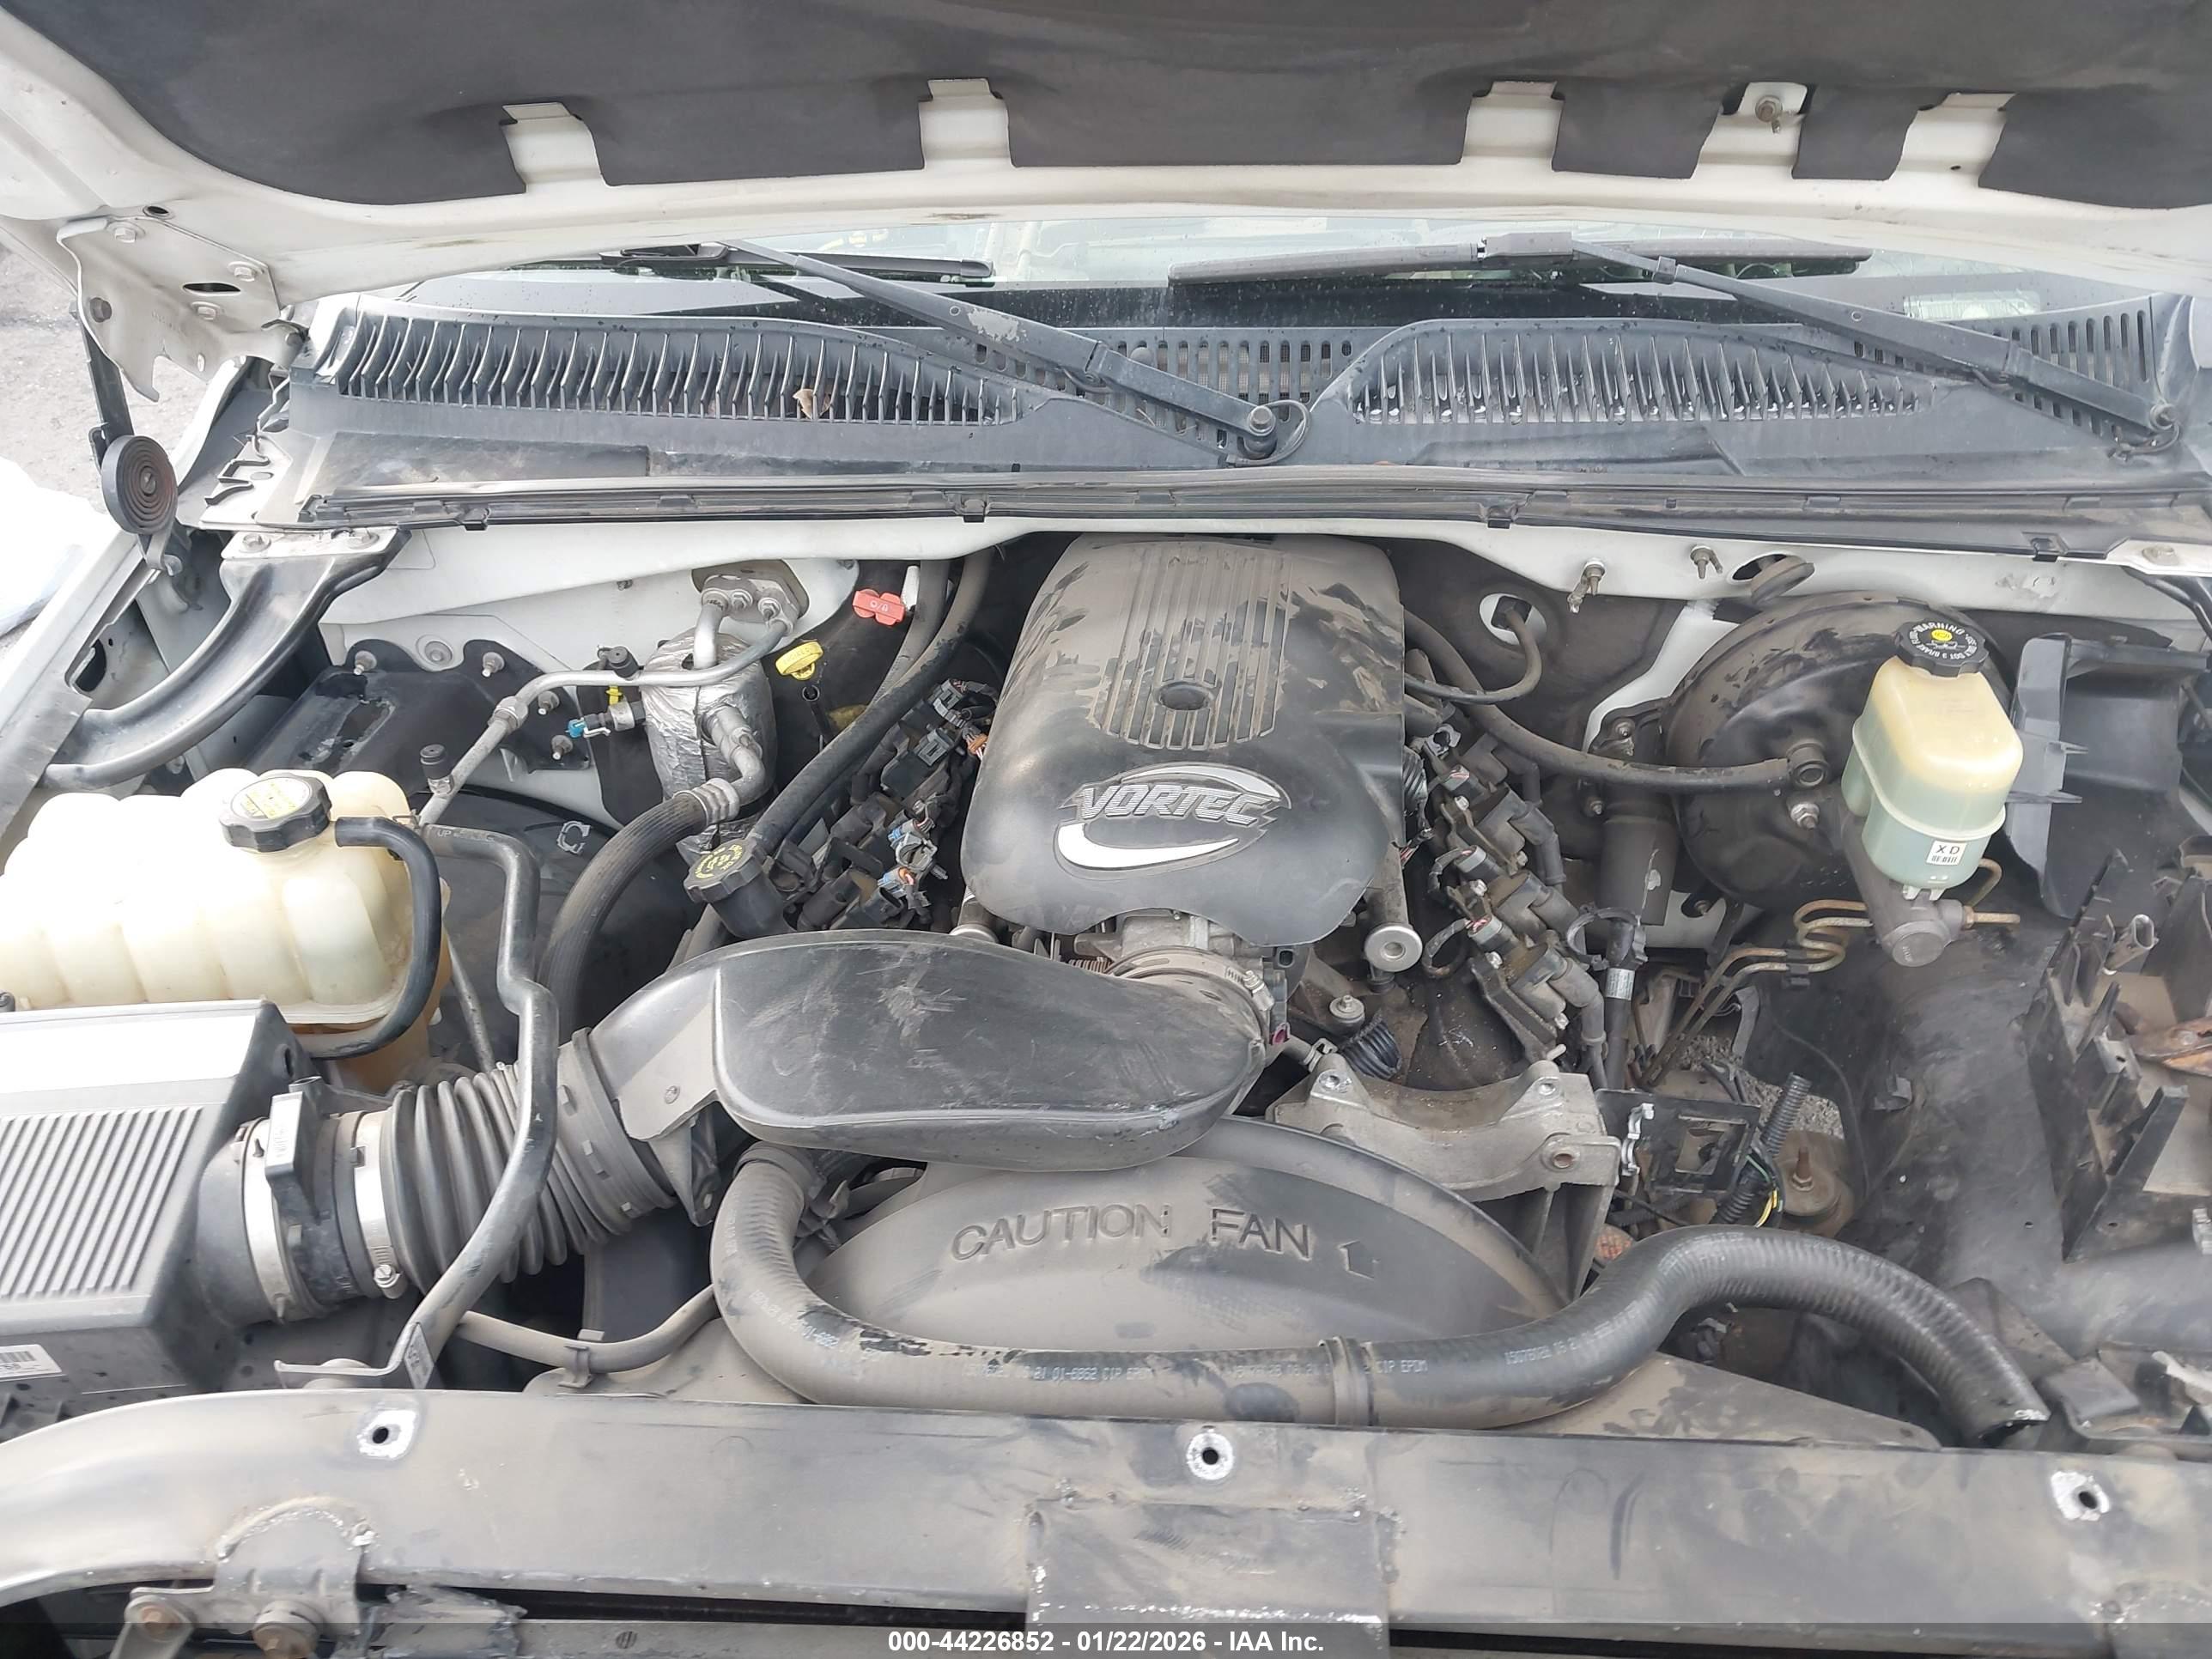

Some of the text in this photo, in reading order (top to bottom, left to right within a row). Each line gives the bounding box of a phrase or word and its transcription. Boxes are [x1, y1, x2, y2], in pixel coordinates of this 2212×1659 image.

[1075, 783, 1273, 826] VORTEC
[951, 1203, 1312, 1261] CAUTION FAN
